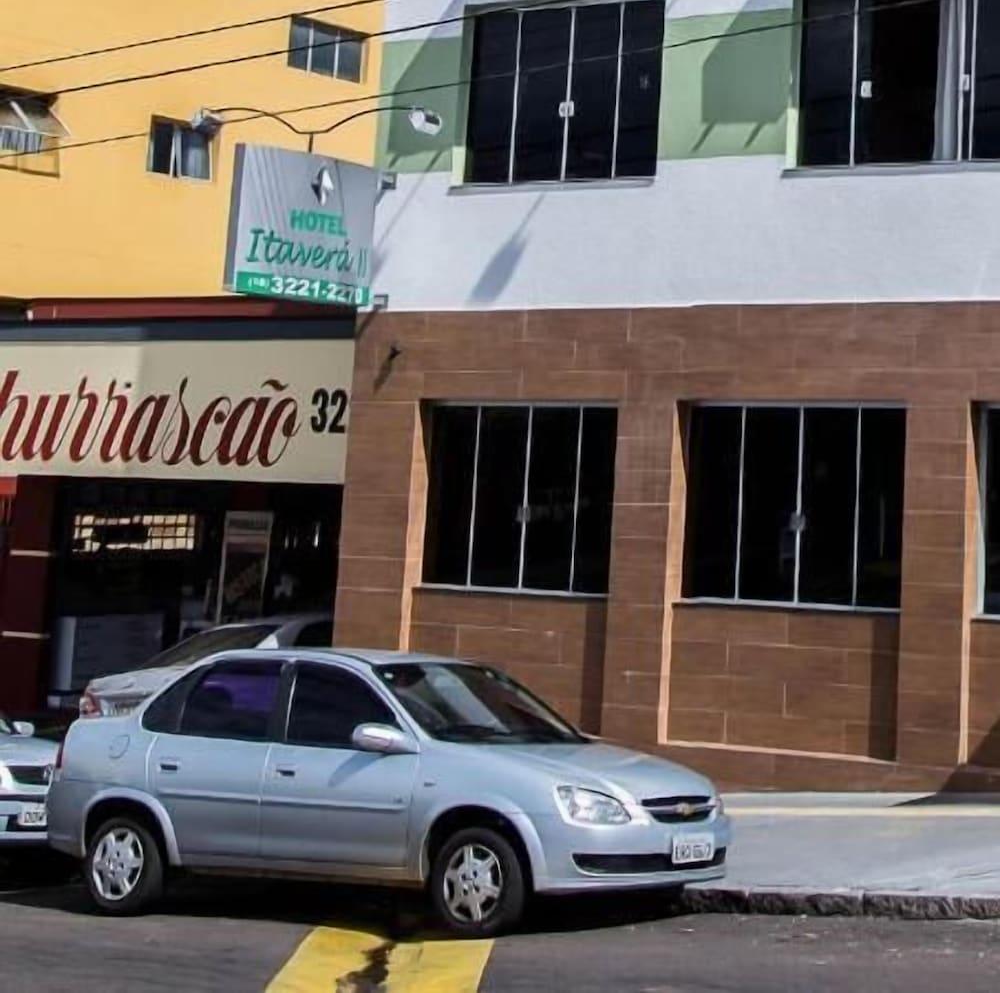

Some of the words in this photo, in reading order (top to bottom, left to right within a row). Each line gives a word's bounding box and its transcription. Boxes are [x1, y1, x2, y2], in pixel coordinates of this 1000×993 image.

[290, 209, 348, 237] HOTEL
[246, 228, 354, 273] Itaverá
[310, 387, 347, 435] 32
